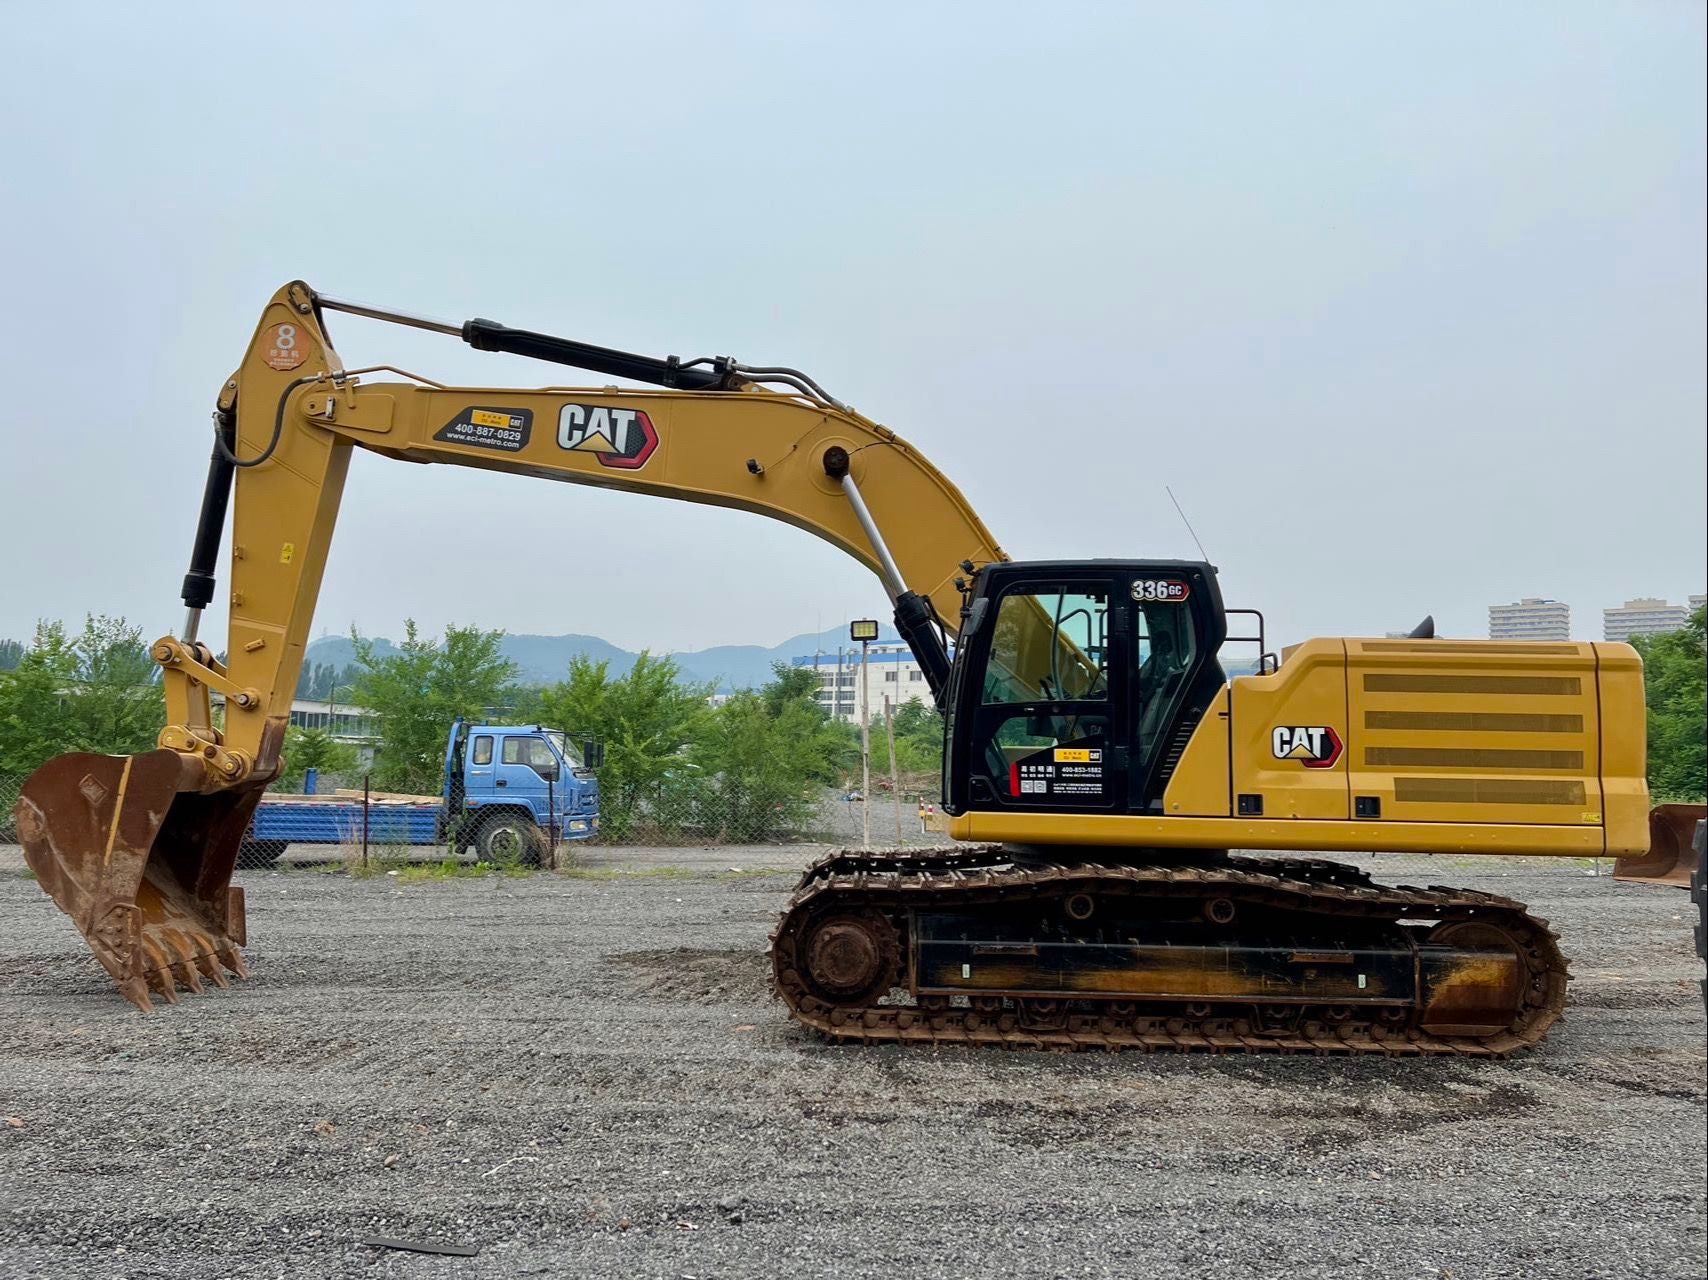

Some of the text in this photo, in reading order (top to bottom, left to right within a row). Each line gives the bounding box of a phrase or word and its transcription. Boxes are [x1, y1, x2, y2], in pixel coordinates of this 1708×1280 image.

[276, 324, 296, 350] 8
[446, 432, 520, 448] www.eci-metro.com
[455, 424, 521, 440] 400-887-0829
[558, 404, 636, 454] CAT
[1273, 726, 1325, 758] CAT
